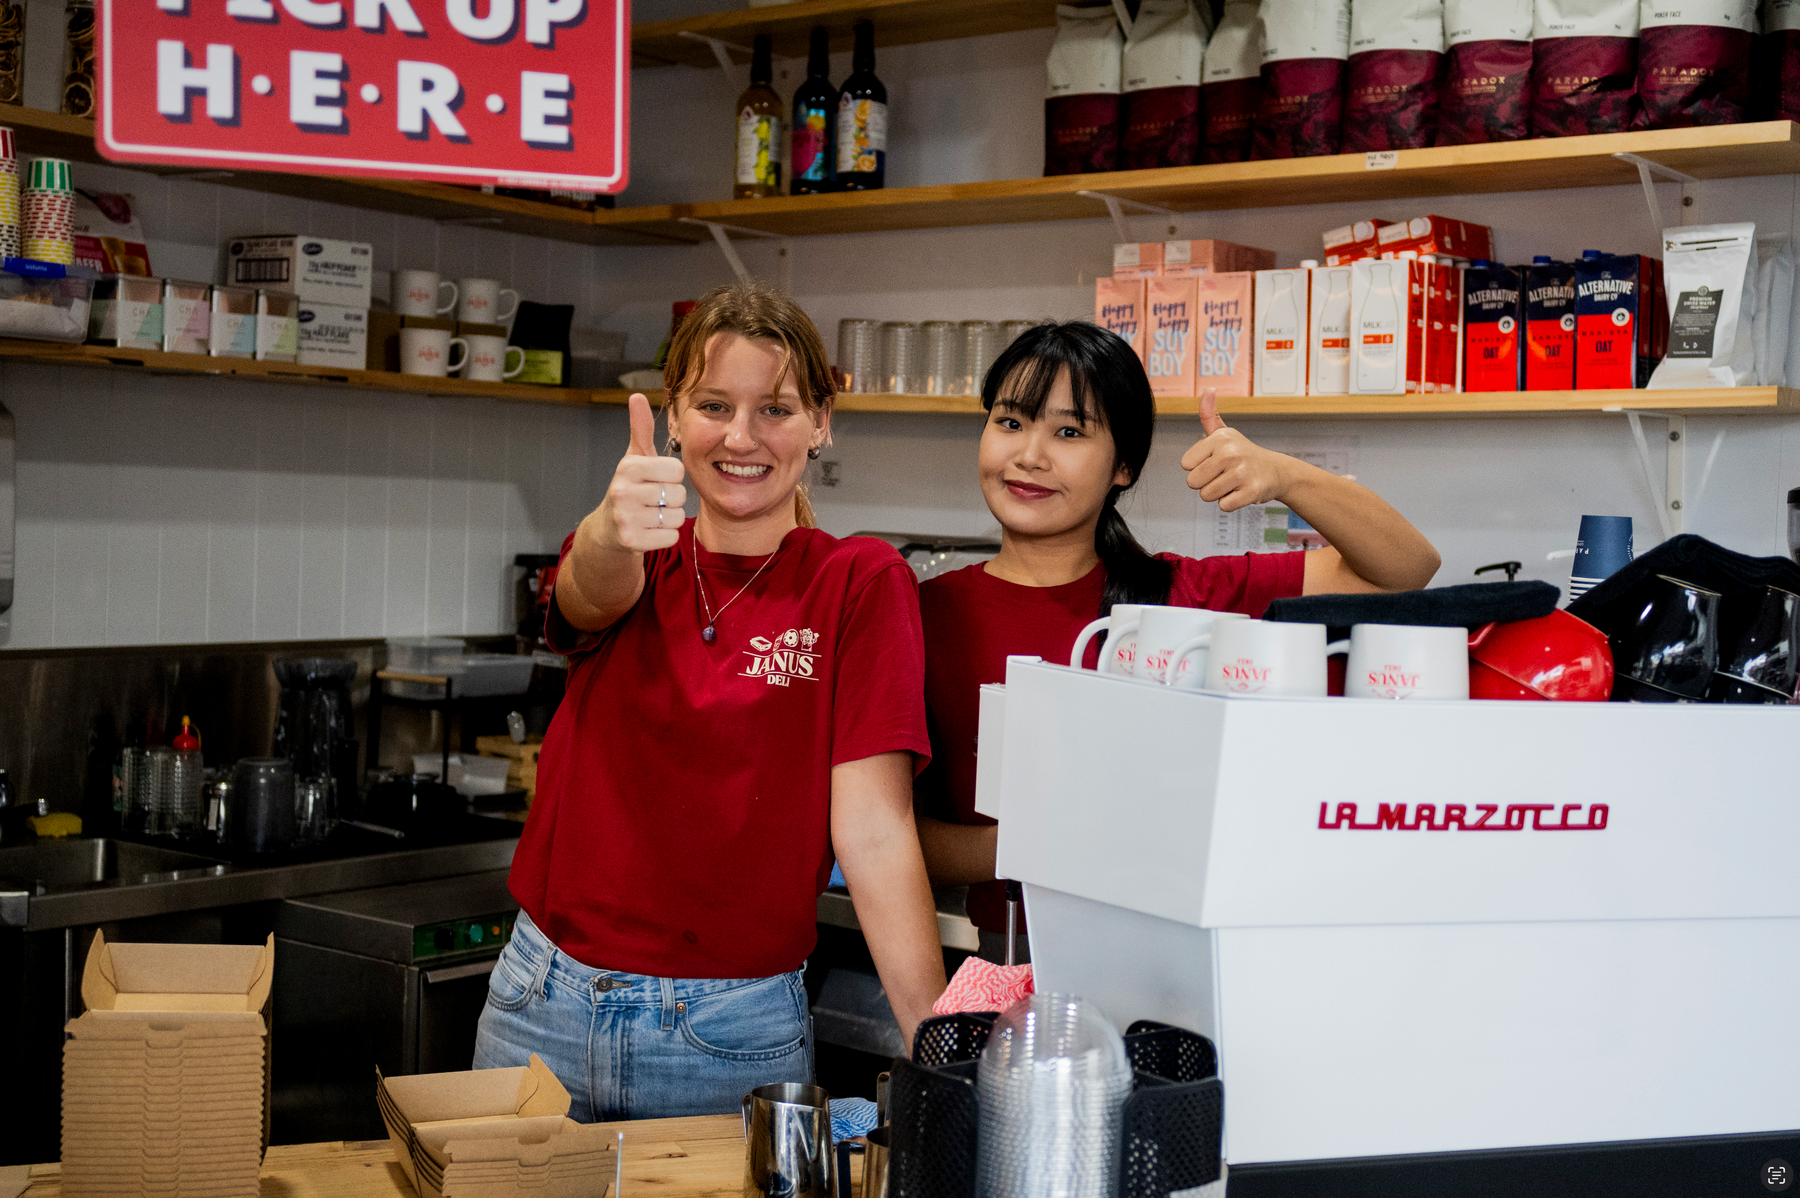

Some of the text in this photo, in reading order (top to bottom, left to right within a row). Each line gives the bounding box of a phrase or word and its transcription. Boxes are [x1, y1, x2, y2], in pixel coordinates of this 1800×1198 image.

[1547, 76, 1601, 86] PARADO
[1468, 288, 1519, 306] ALTERNATIVE
[1578, 279, 1634, 297] ALTERNATIVE
[1153, 301, 1187, 319] Happy
[1204, 299, 1239, 317] Happy
[1153, 327, 1190, 352] SOY
[1204, 327, 1244, 352] SOY
[1595, 341, 1613, 353] OAT
[1483, 347, 1499, 359] OAT
[1544, 345, 1561, 358] OAT
[1148, 351, 1188, 377] BOY
[1199, 351, 1241, 377] BOY
[745, 651, 814, 677] JANUS
[766, 674, 790, 688] DELI
[1222, 666, 1272, 681] JANUS
[1368, 672, 1420, 688] JANUS
[1317, 801, 1357, 830] LA
